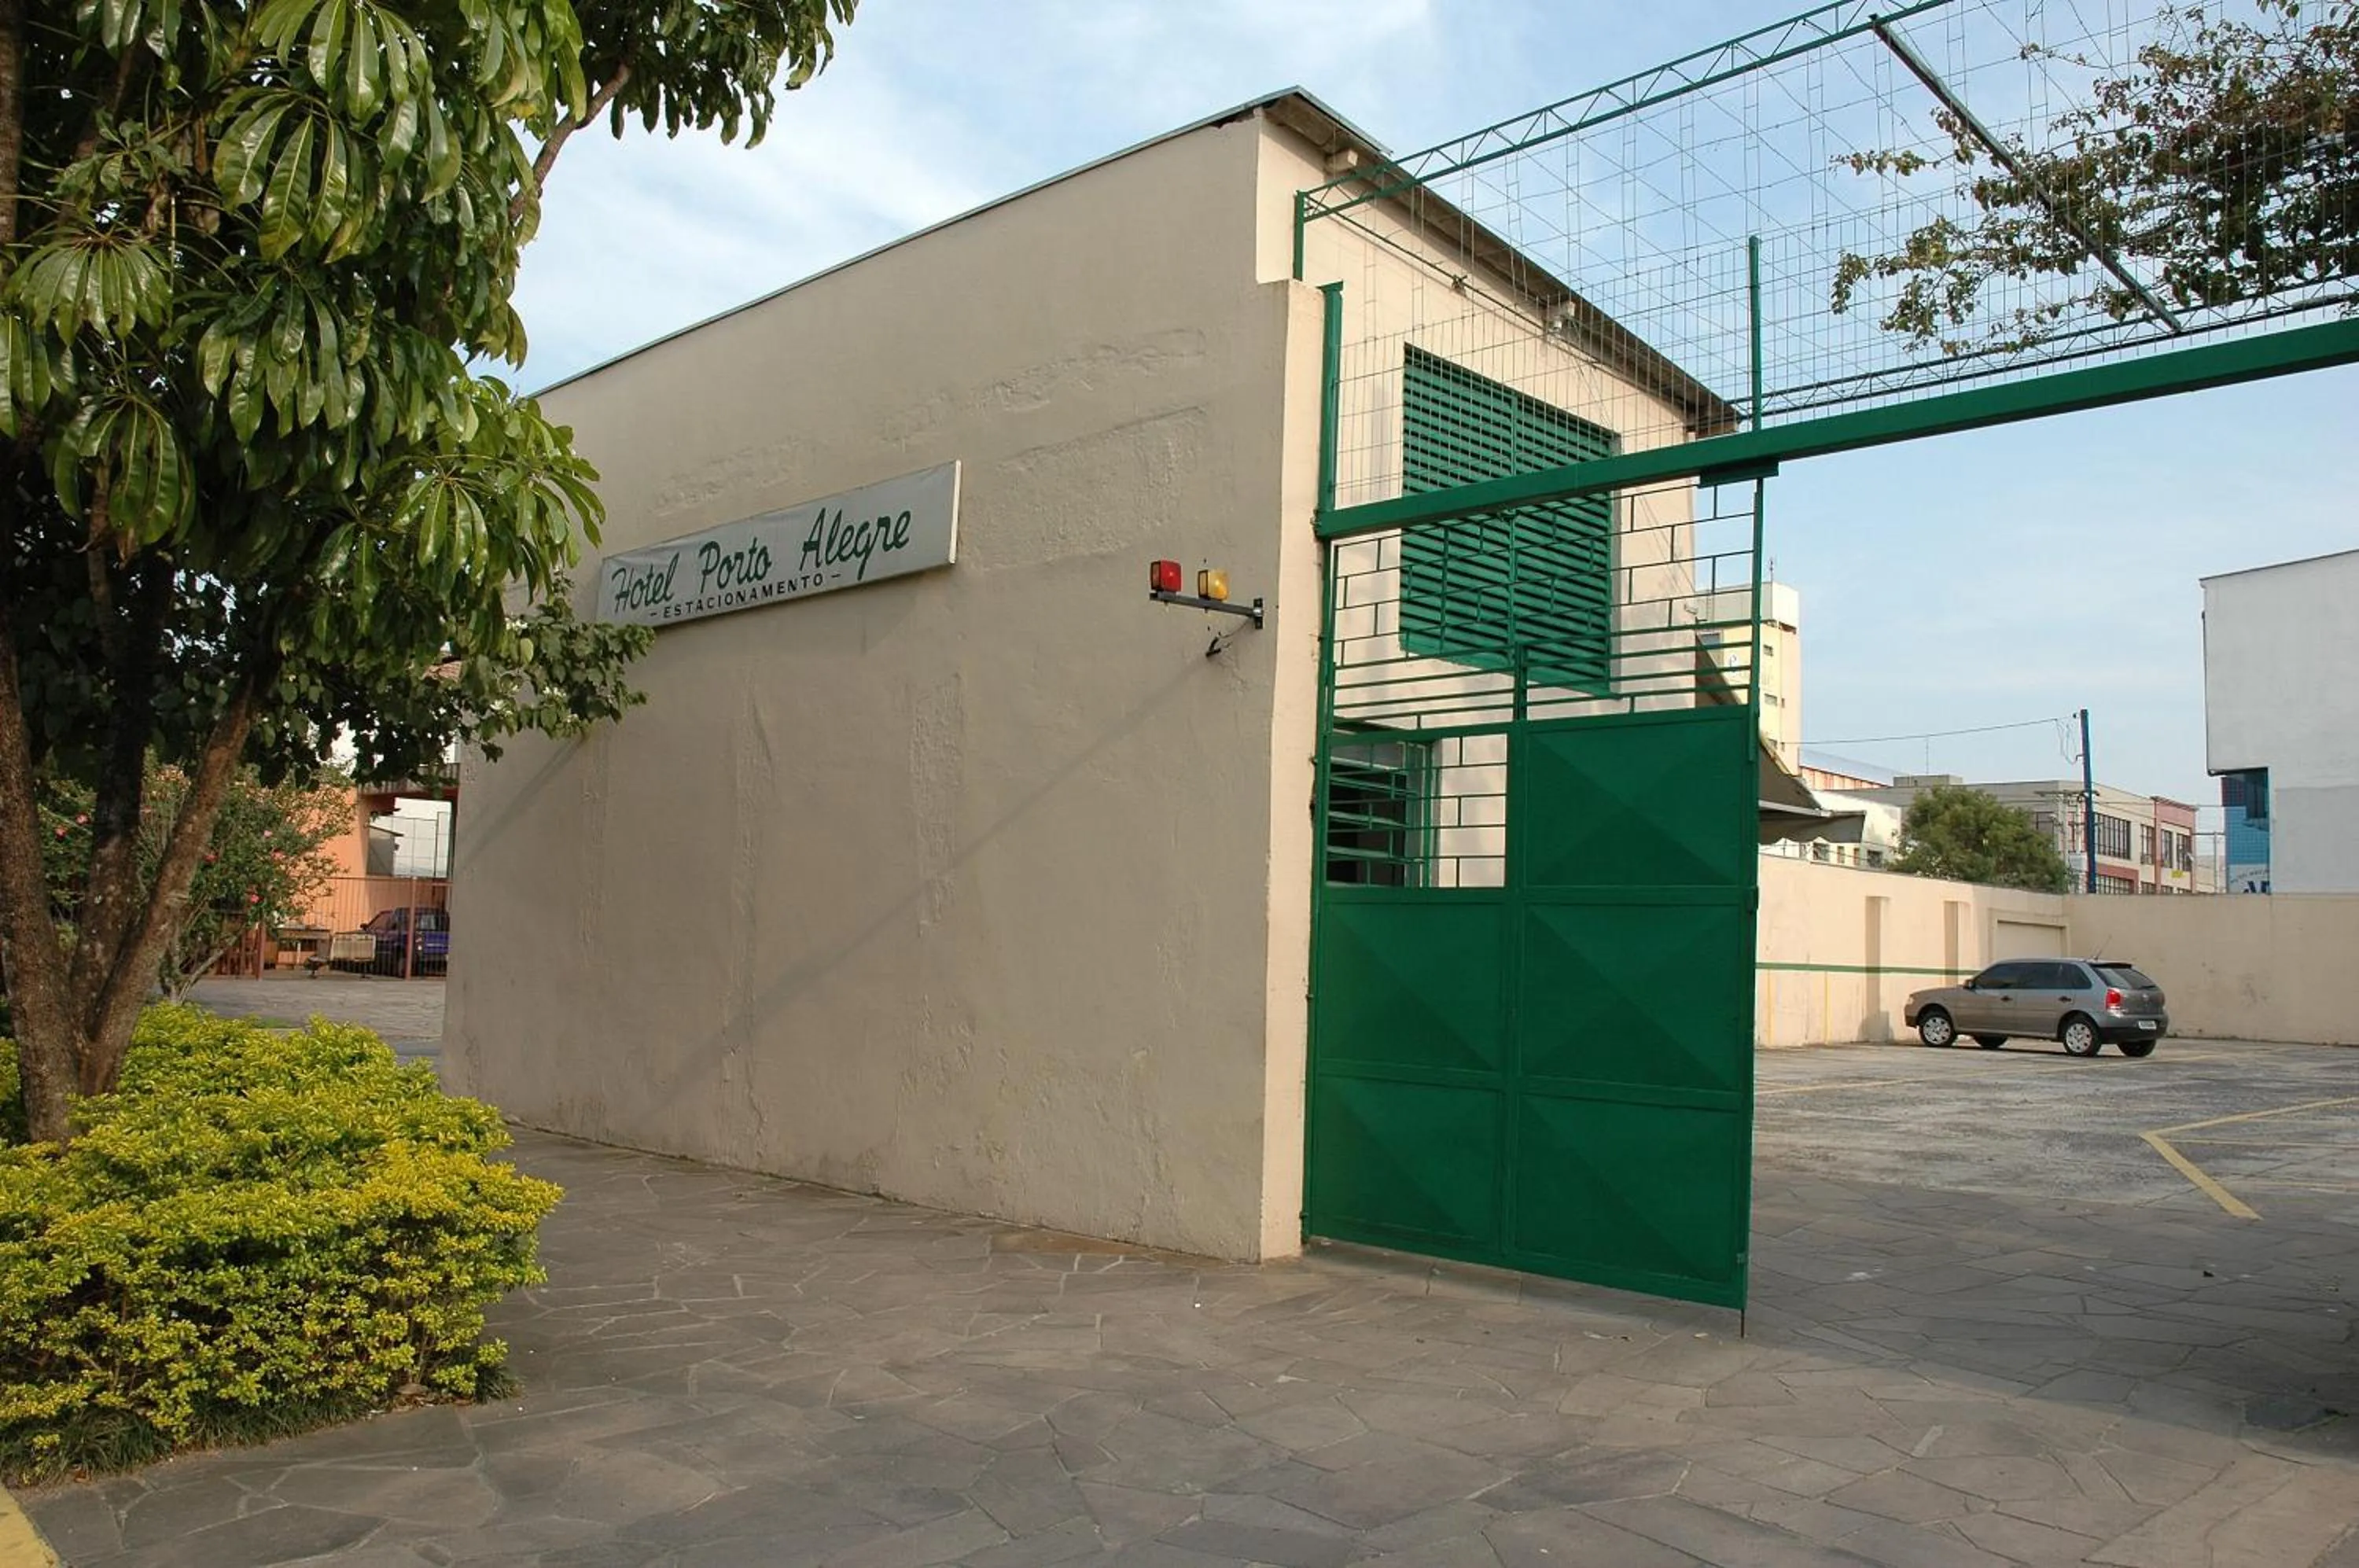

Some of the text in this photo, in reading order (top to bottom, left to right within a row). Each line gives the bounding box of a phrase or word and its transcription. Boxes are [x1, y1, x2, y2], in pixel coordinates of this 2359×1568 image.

[611, 507, 911, 613] Hotel Porto Alegre
